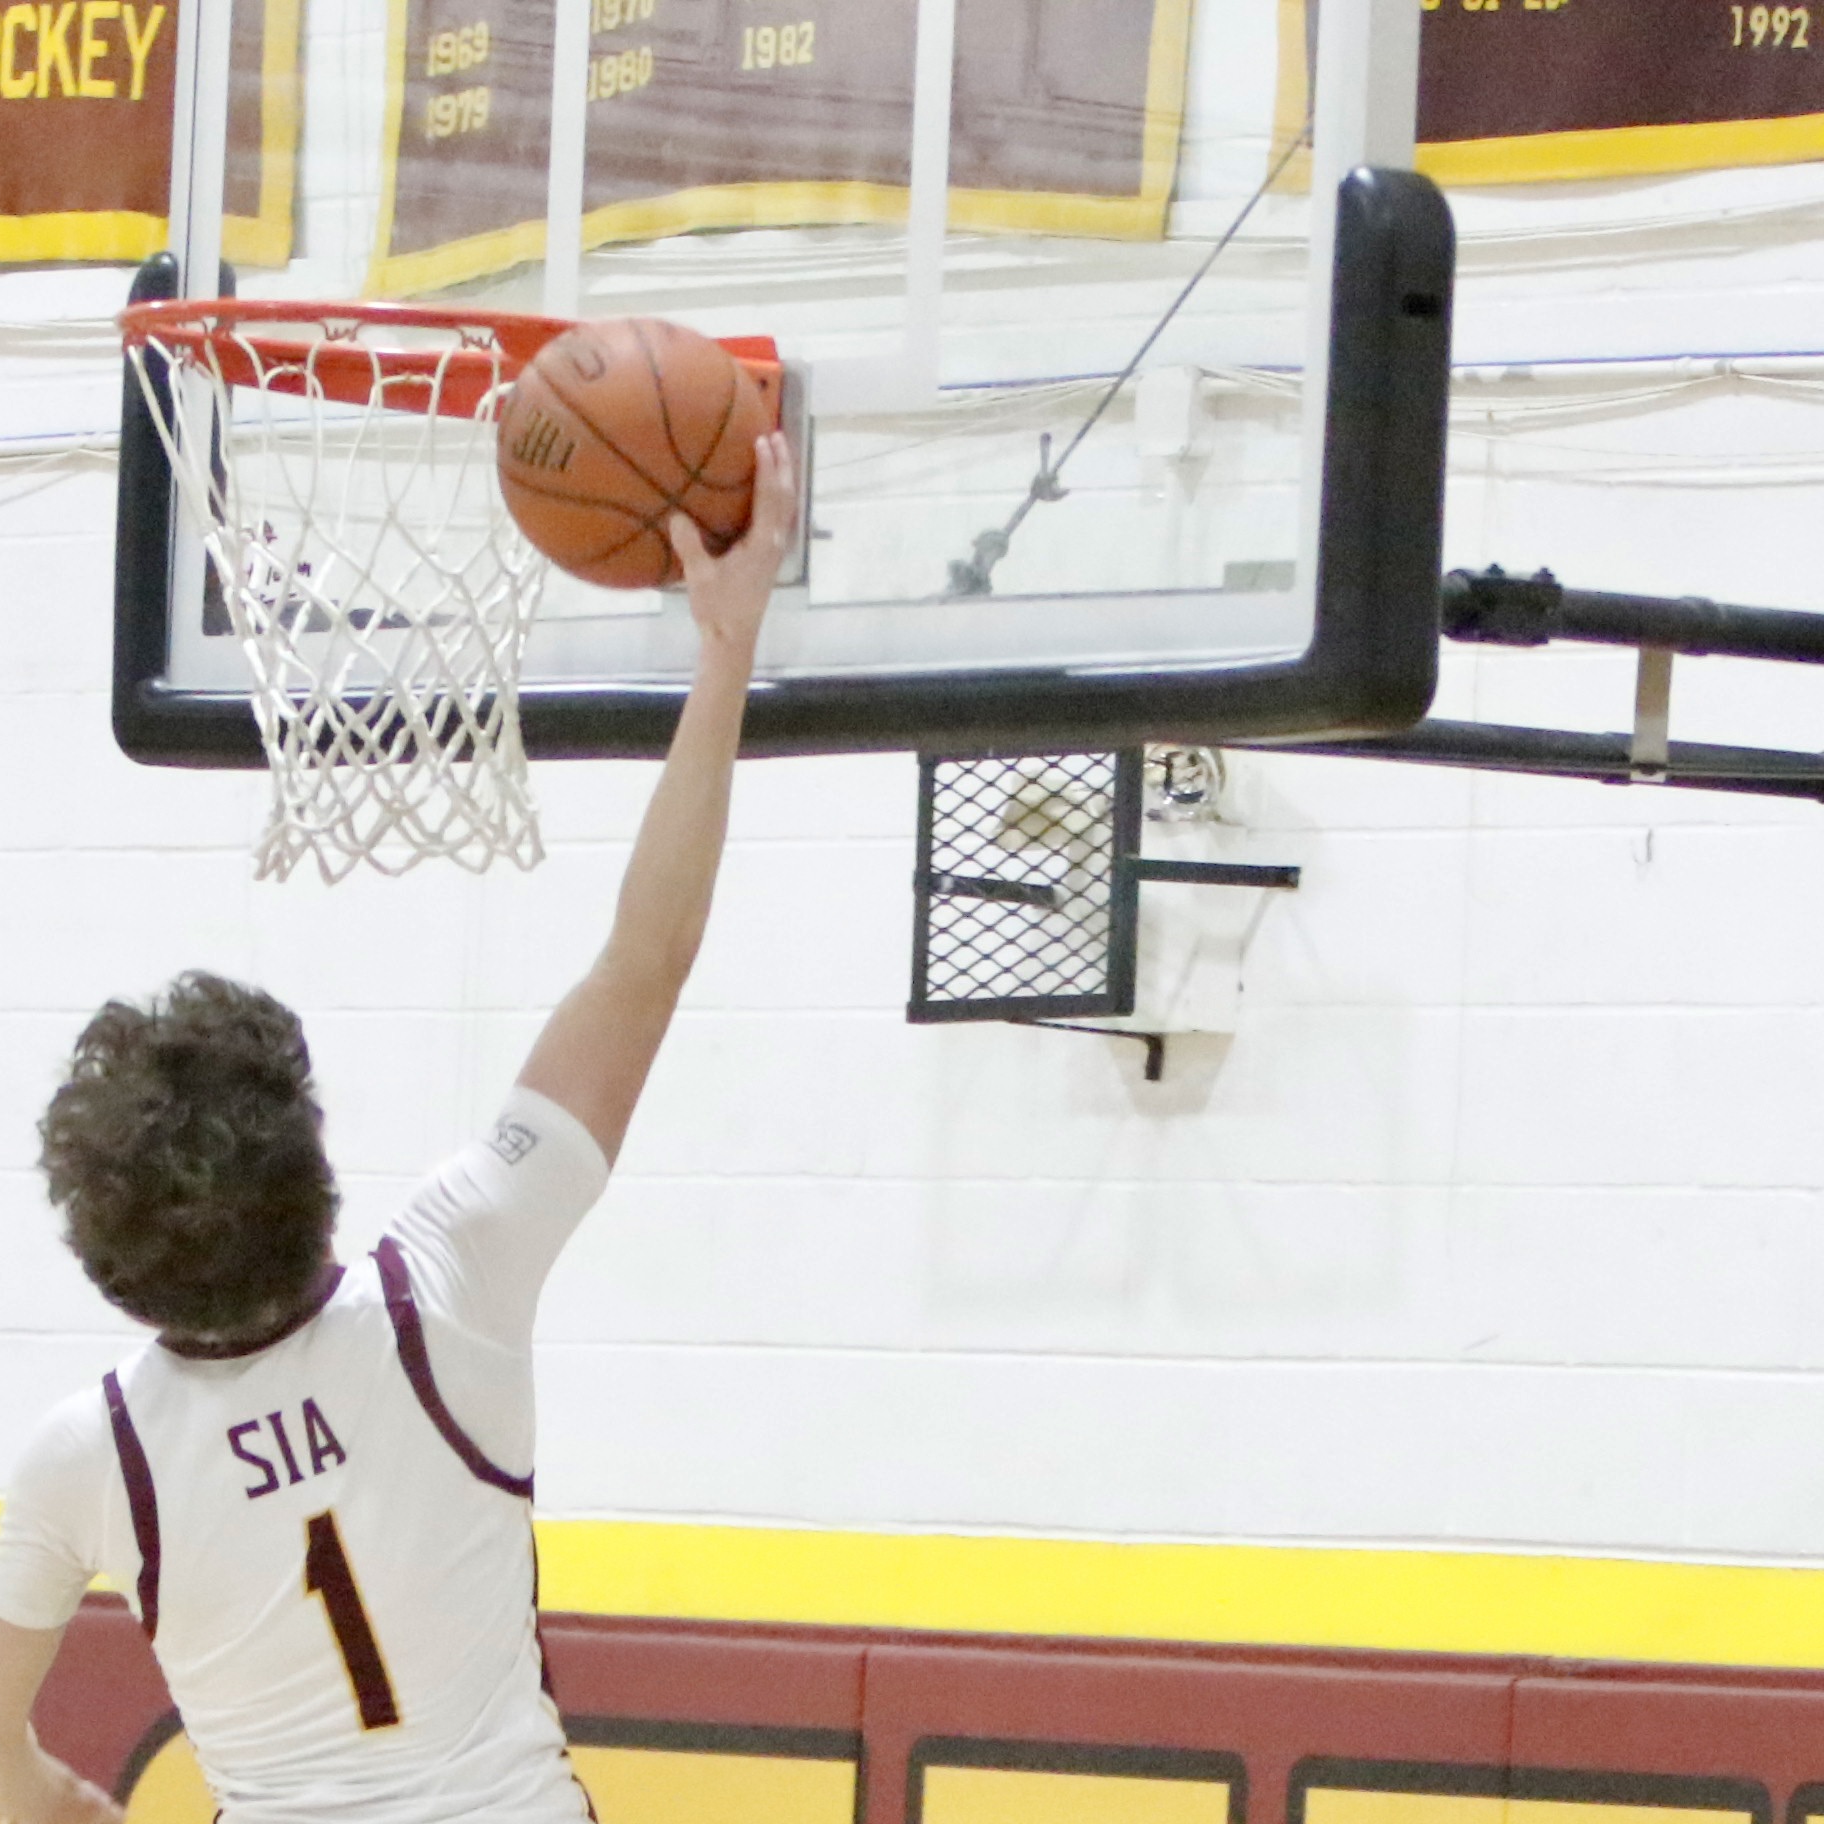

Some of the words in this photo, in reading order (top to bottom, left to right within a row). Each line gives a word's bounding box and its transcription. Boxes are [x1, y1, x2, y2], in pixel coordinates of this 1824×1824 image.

[426, 21, 491, 77] 1969
[741, 21, 816, 71] 1982
[1730, 5, 1810, 49] 1992
[587, 46, 654, 101] 1980
[425, 86, 491, 139] 1979
[227, 1396, 349, 1500] SIA
[302, 1509, 402, 1732] 1
